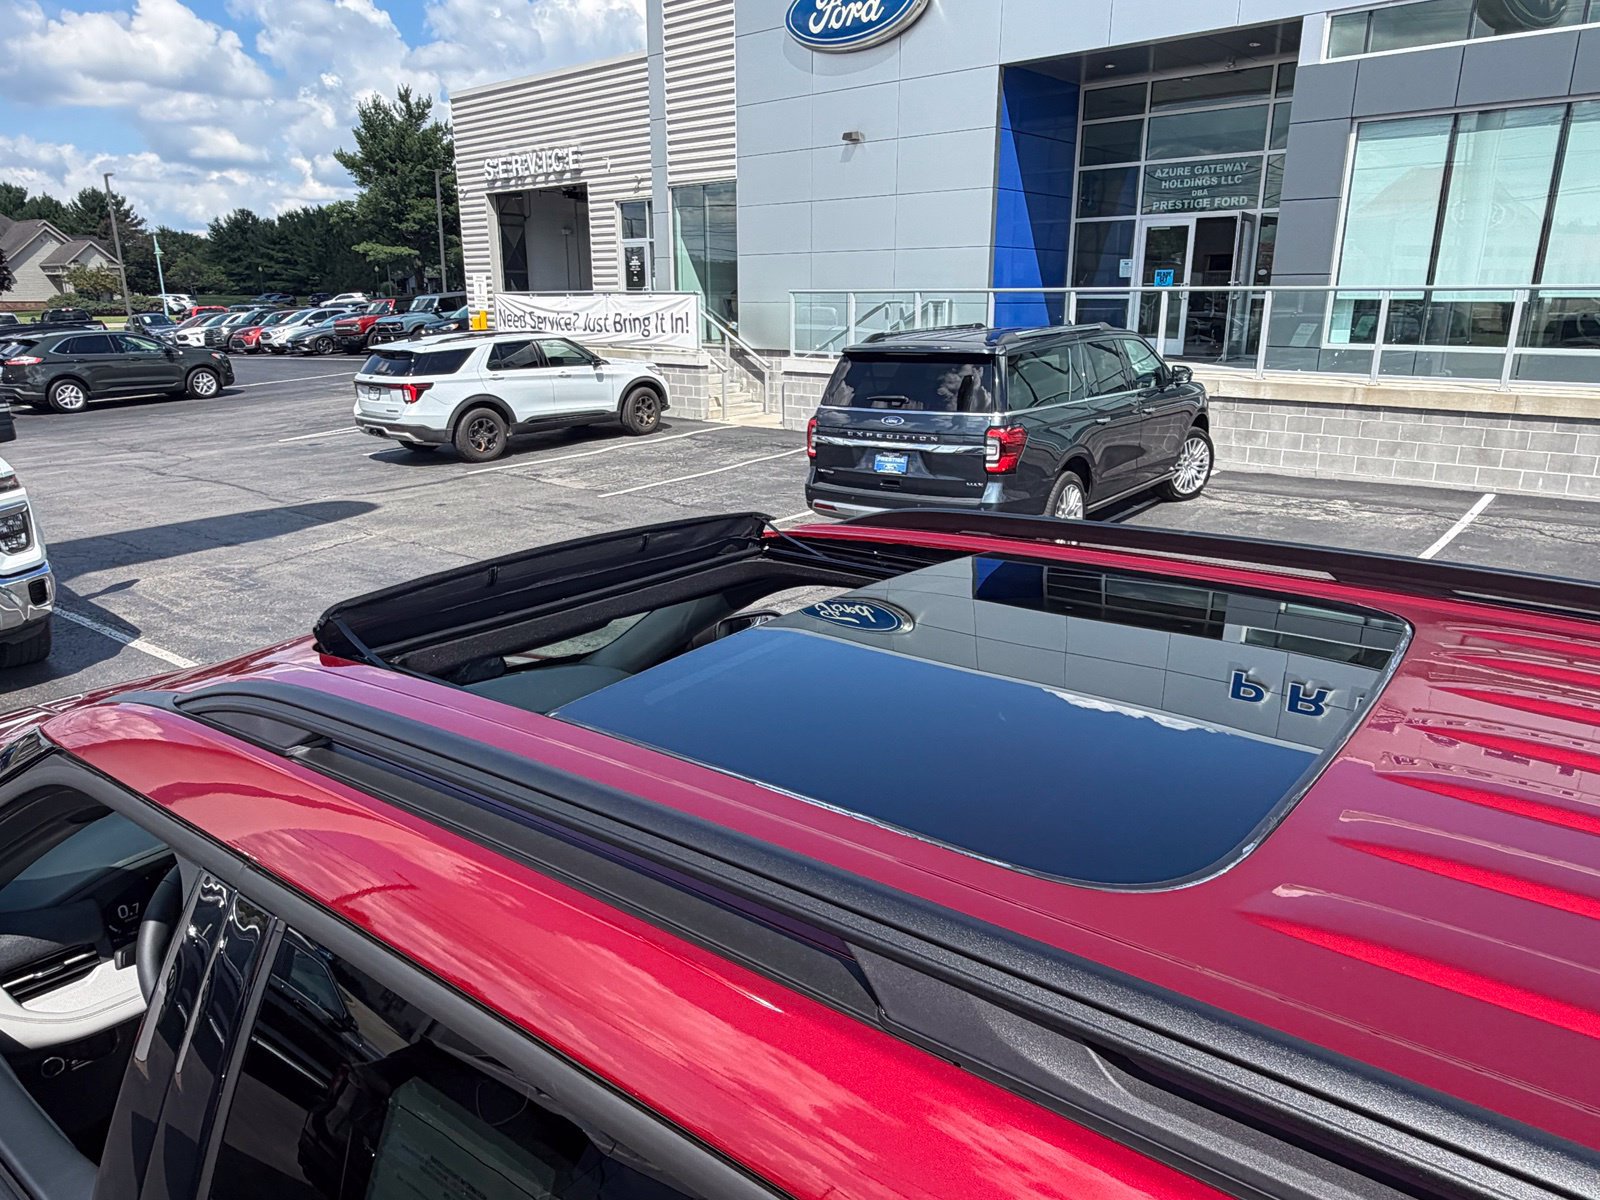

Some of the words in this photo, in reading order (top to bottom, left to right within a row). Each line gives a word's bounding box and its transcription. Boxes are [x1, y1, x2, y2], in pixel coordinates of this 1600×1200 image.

[809, 0, 885, 34] Ford
[483, 146, 581, 180] SERVICE
[1155, 167, 1191, 178] AZURE
[1194, 161, 1249, 175] GATEWAY
[1161, 176, 1218, 189] HOLDINGS
[1221, 174, 1243, 185] LLC
[1191, 188, 1209, 197] DBA
[1152, 198, 1211, 210] PRESTIGE
[1214, 195, 1248, 207] FORD
[498, 308, 526, 329] Need
[530, 311, 579, 331] Service?
[582, 311, 609, 333] Just
[612, 312, 651, 337] Bring
[654, 312, 667, 333] It
[670, 312, 689, 334] In!
[848, 431, 938, 442] EXPEDITION
